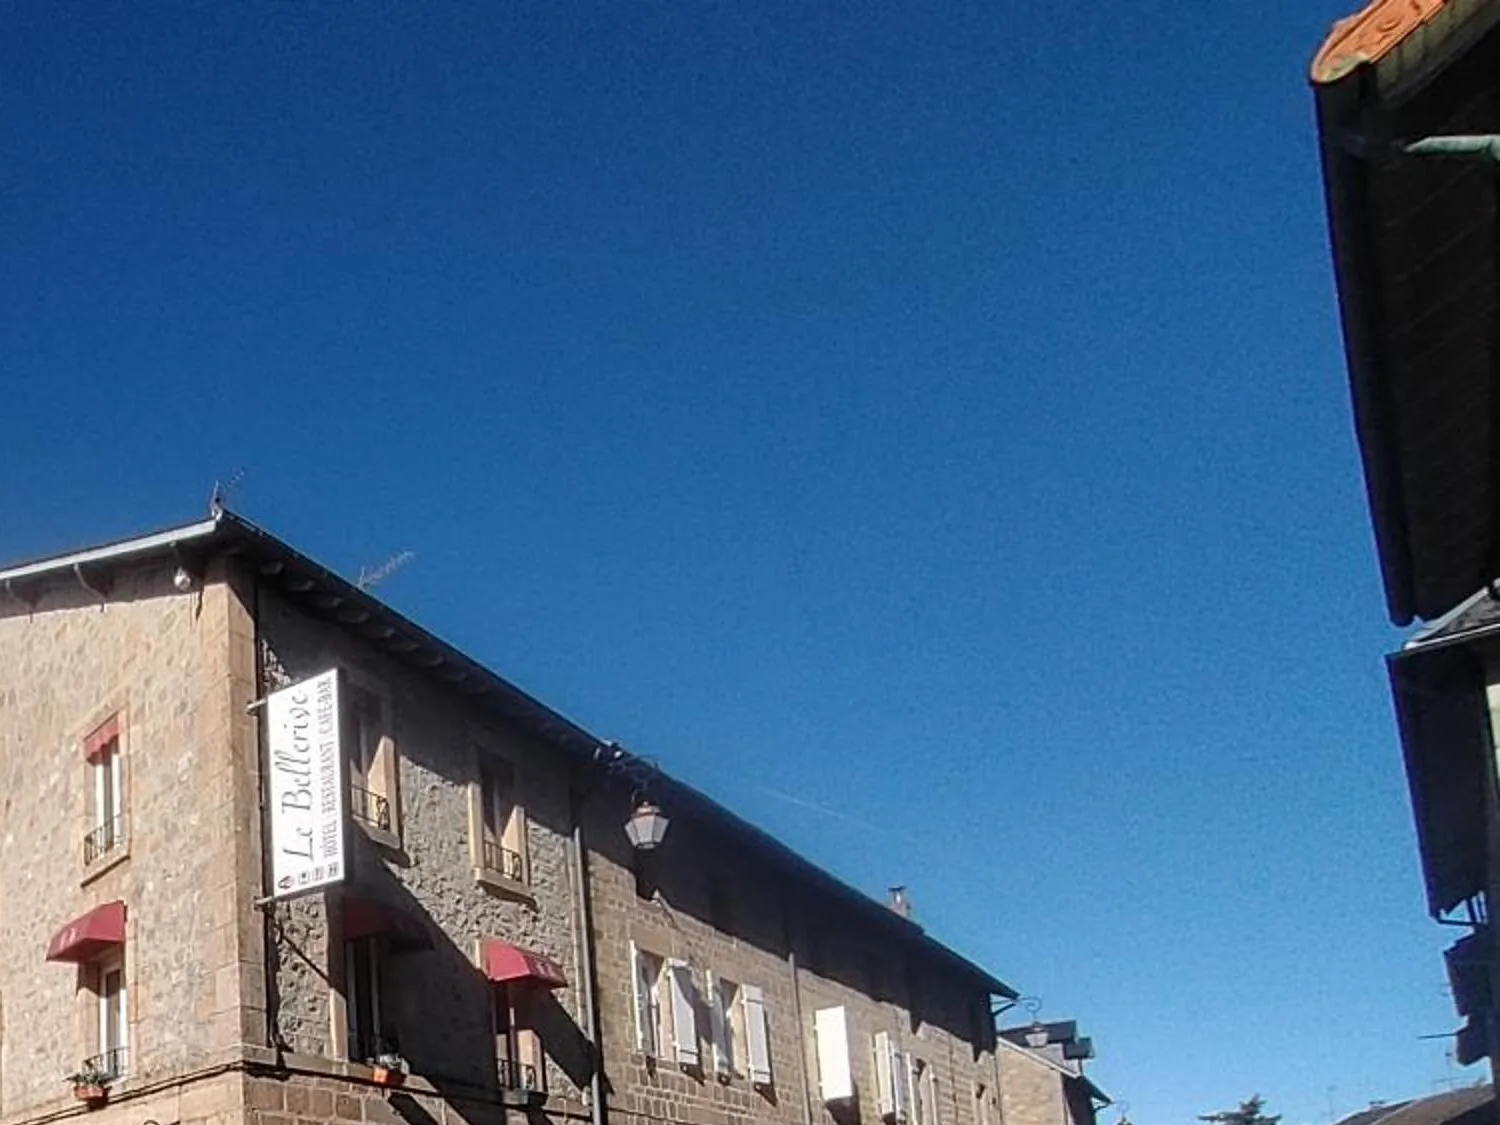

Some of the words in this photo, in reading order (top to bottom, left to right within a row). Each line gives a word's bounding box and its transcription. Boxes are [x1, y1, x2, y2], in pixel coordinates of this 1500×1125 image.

[274, 692, 312, 814] Bellerive
[320, 741, 336, 814] RESTAURANT
[282, 826, 313, 862] Le
